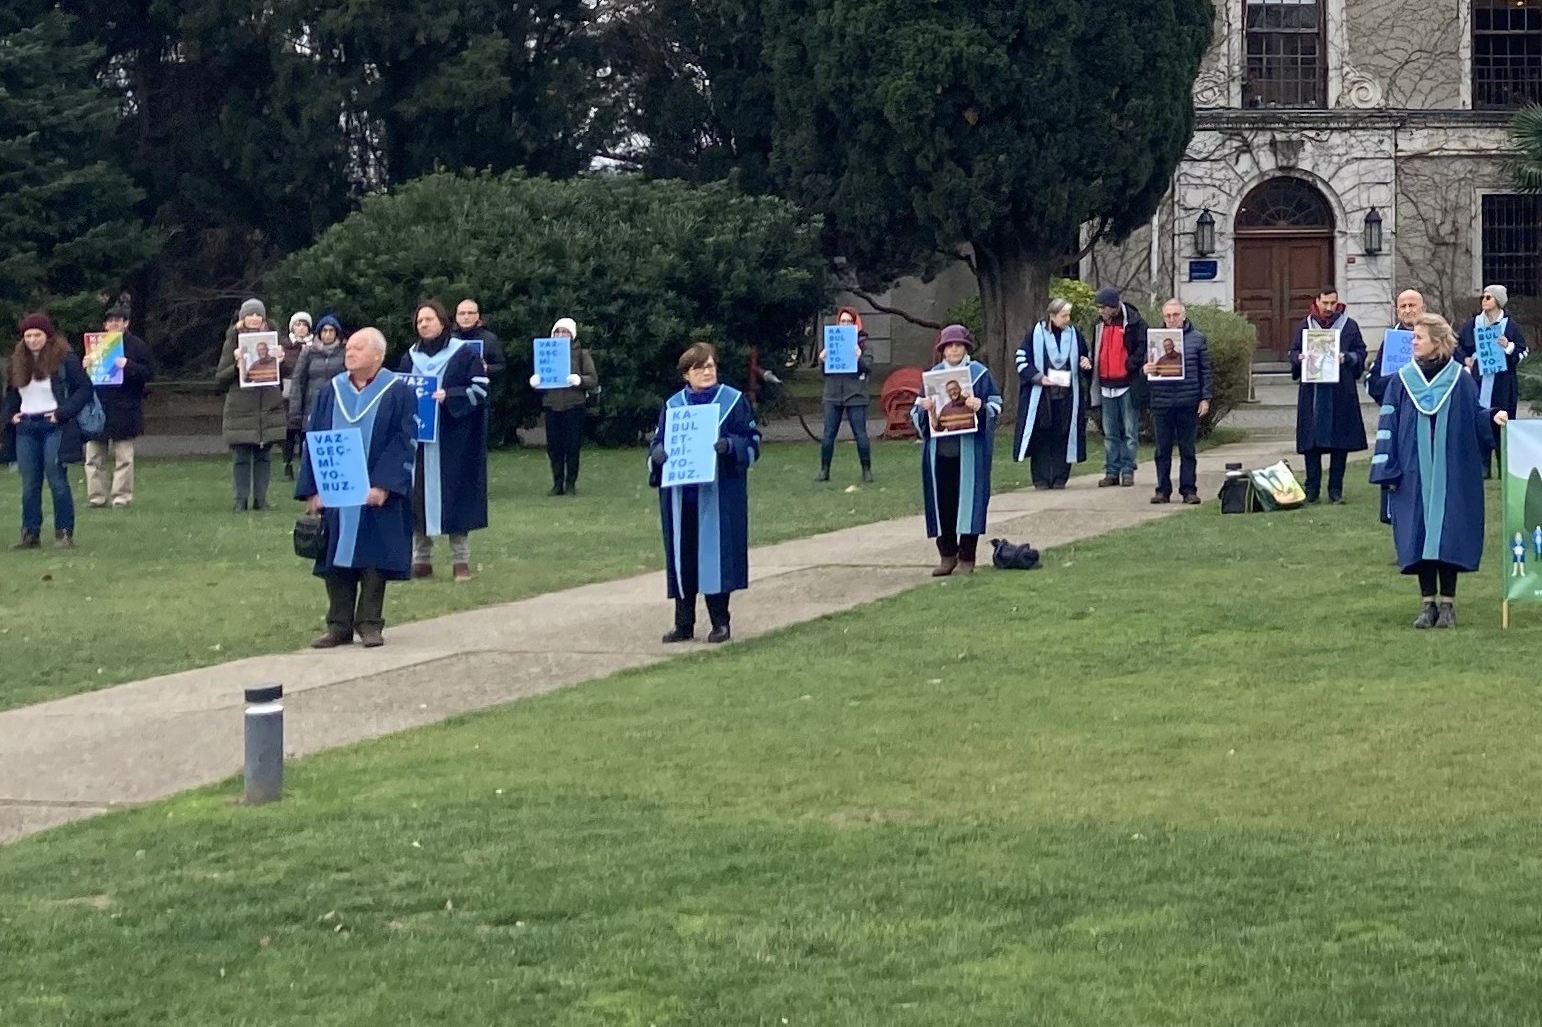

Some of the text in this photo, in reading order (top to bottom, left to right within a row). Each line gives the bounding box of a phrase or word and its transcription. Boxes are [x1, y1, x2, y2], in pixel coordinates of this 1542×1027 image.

[1479, 333, 1498, 341] BUL
[673, 411, 698, 420] KA-
[672, 421, 698, 432] BUL
[314, 433, 349, 444] VAZ-
[671, 434, 692, 445] ET-
[316, 446, 351, 456] GEÇ-
[670, 443, 692, 456] Mİ-
[318, 456, 340, 468] Mİ-
[670, 458, 694, 468] YO-
[320, 470, 345, 480] YO-
[668, 470, 700, 481] RUZ.
[322, 481, 355, 491] RUZ.
